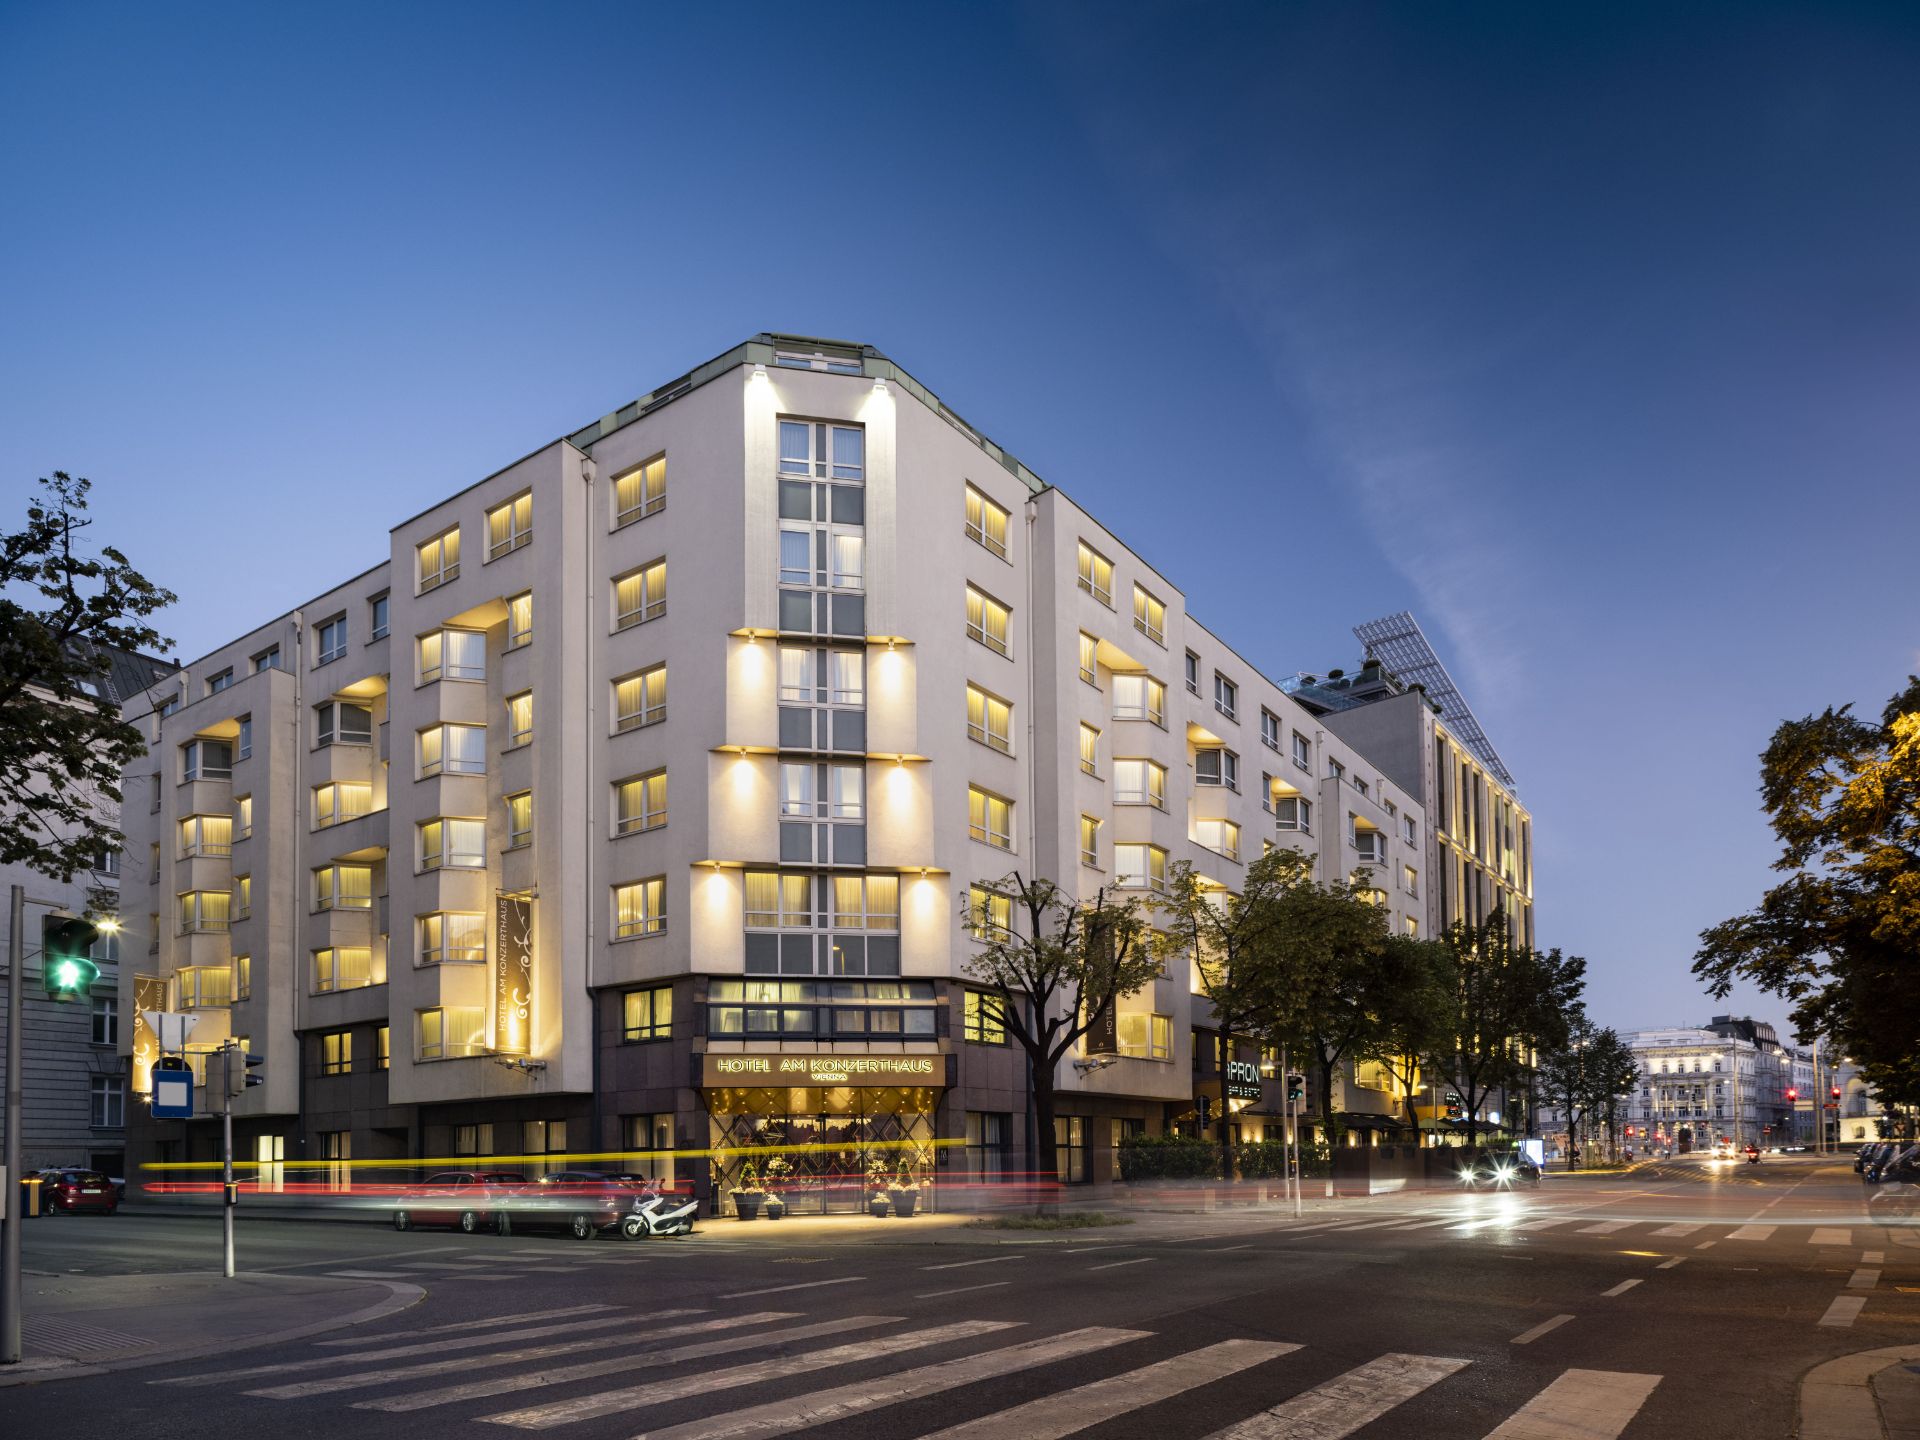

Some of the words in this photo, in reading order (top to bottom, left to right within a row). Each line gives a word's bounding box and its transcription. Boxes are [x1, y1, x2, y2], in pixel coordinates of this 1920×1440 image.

[500, 900, 508, 977] KONZERTHAUS
[500, 979, 507, 995] AM
[499, 998, 507, 1032] HOTEL
[717, 1059, 773, 1073] HOTEL
[780, 1059, 806, 1073] AM
[811, 1059, 933, 1073] KONZERTHAUS
[811, 1073, 848, 1081] VIENNA
